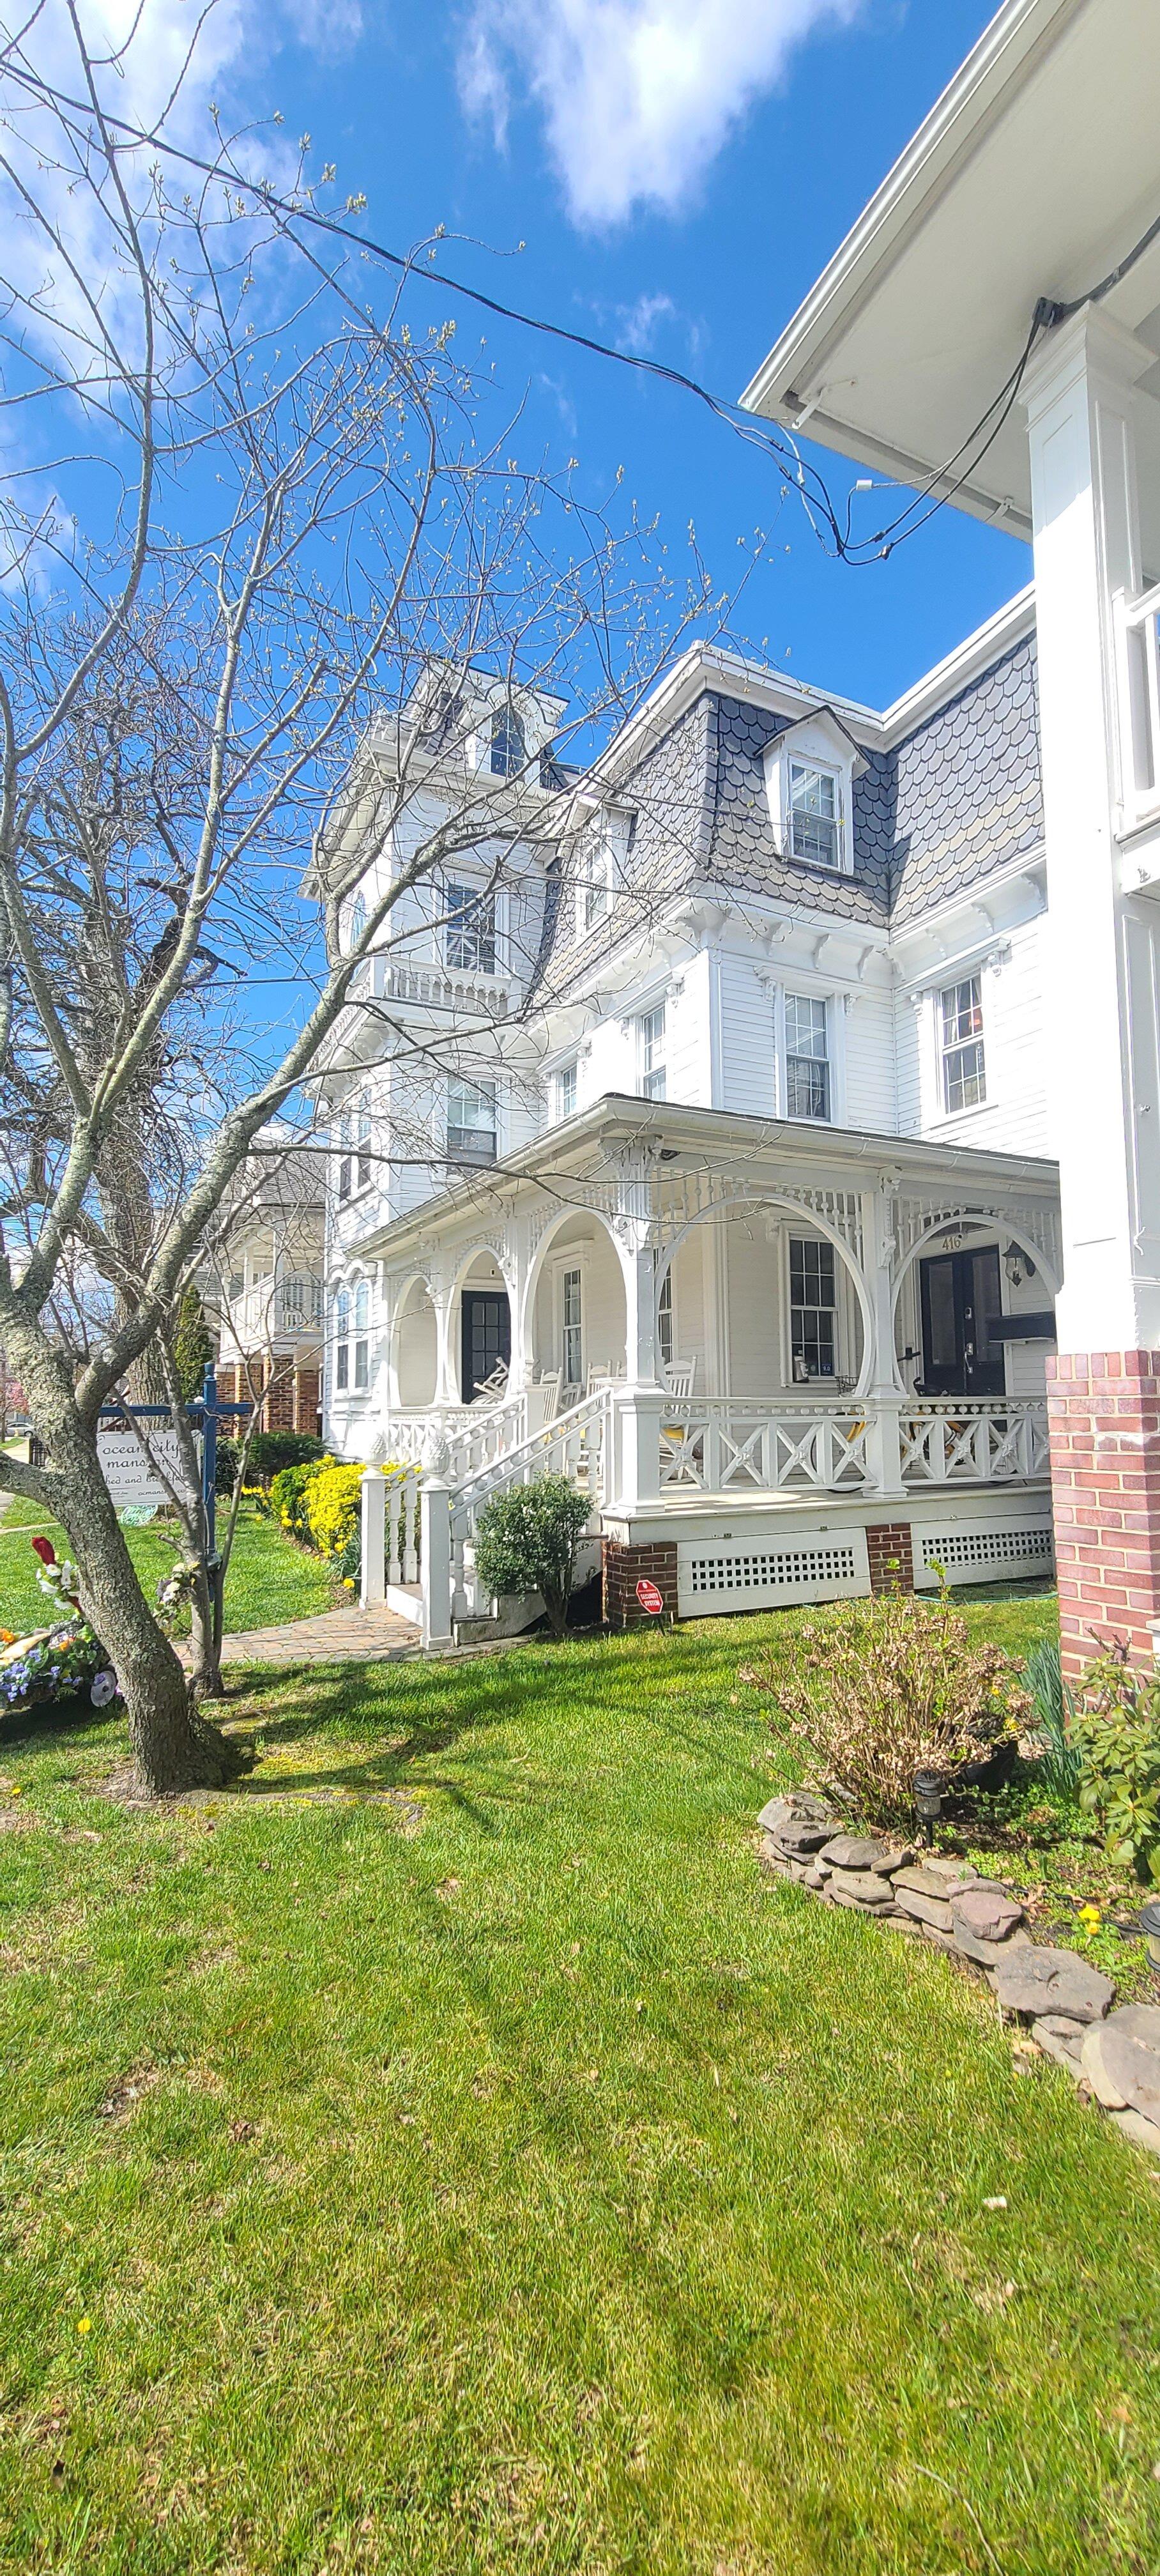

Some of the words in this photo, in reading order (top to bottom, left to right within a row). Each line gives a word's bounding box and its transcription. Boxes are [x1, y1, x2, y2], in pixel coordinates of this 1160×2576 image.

[942, 1236, 961, 1250] 416
[153, 1439, 179, 1458] city
[105, 1474, 121, 1485] bed
[125, 1475, 142, 1483] and
[146, 1471, 185, 1485] brekfa
